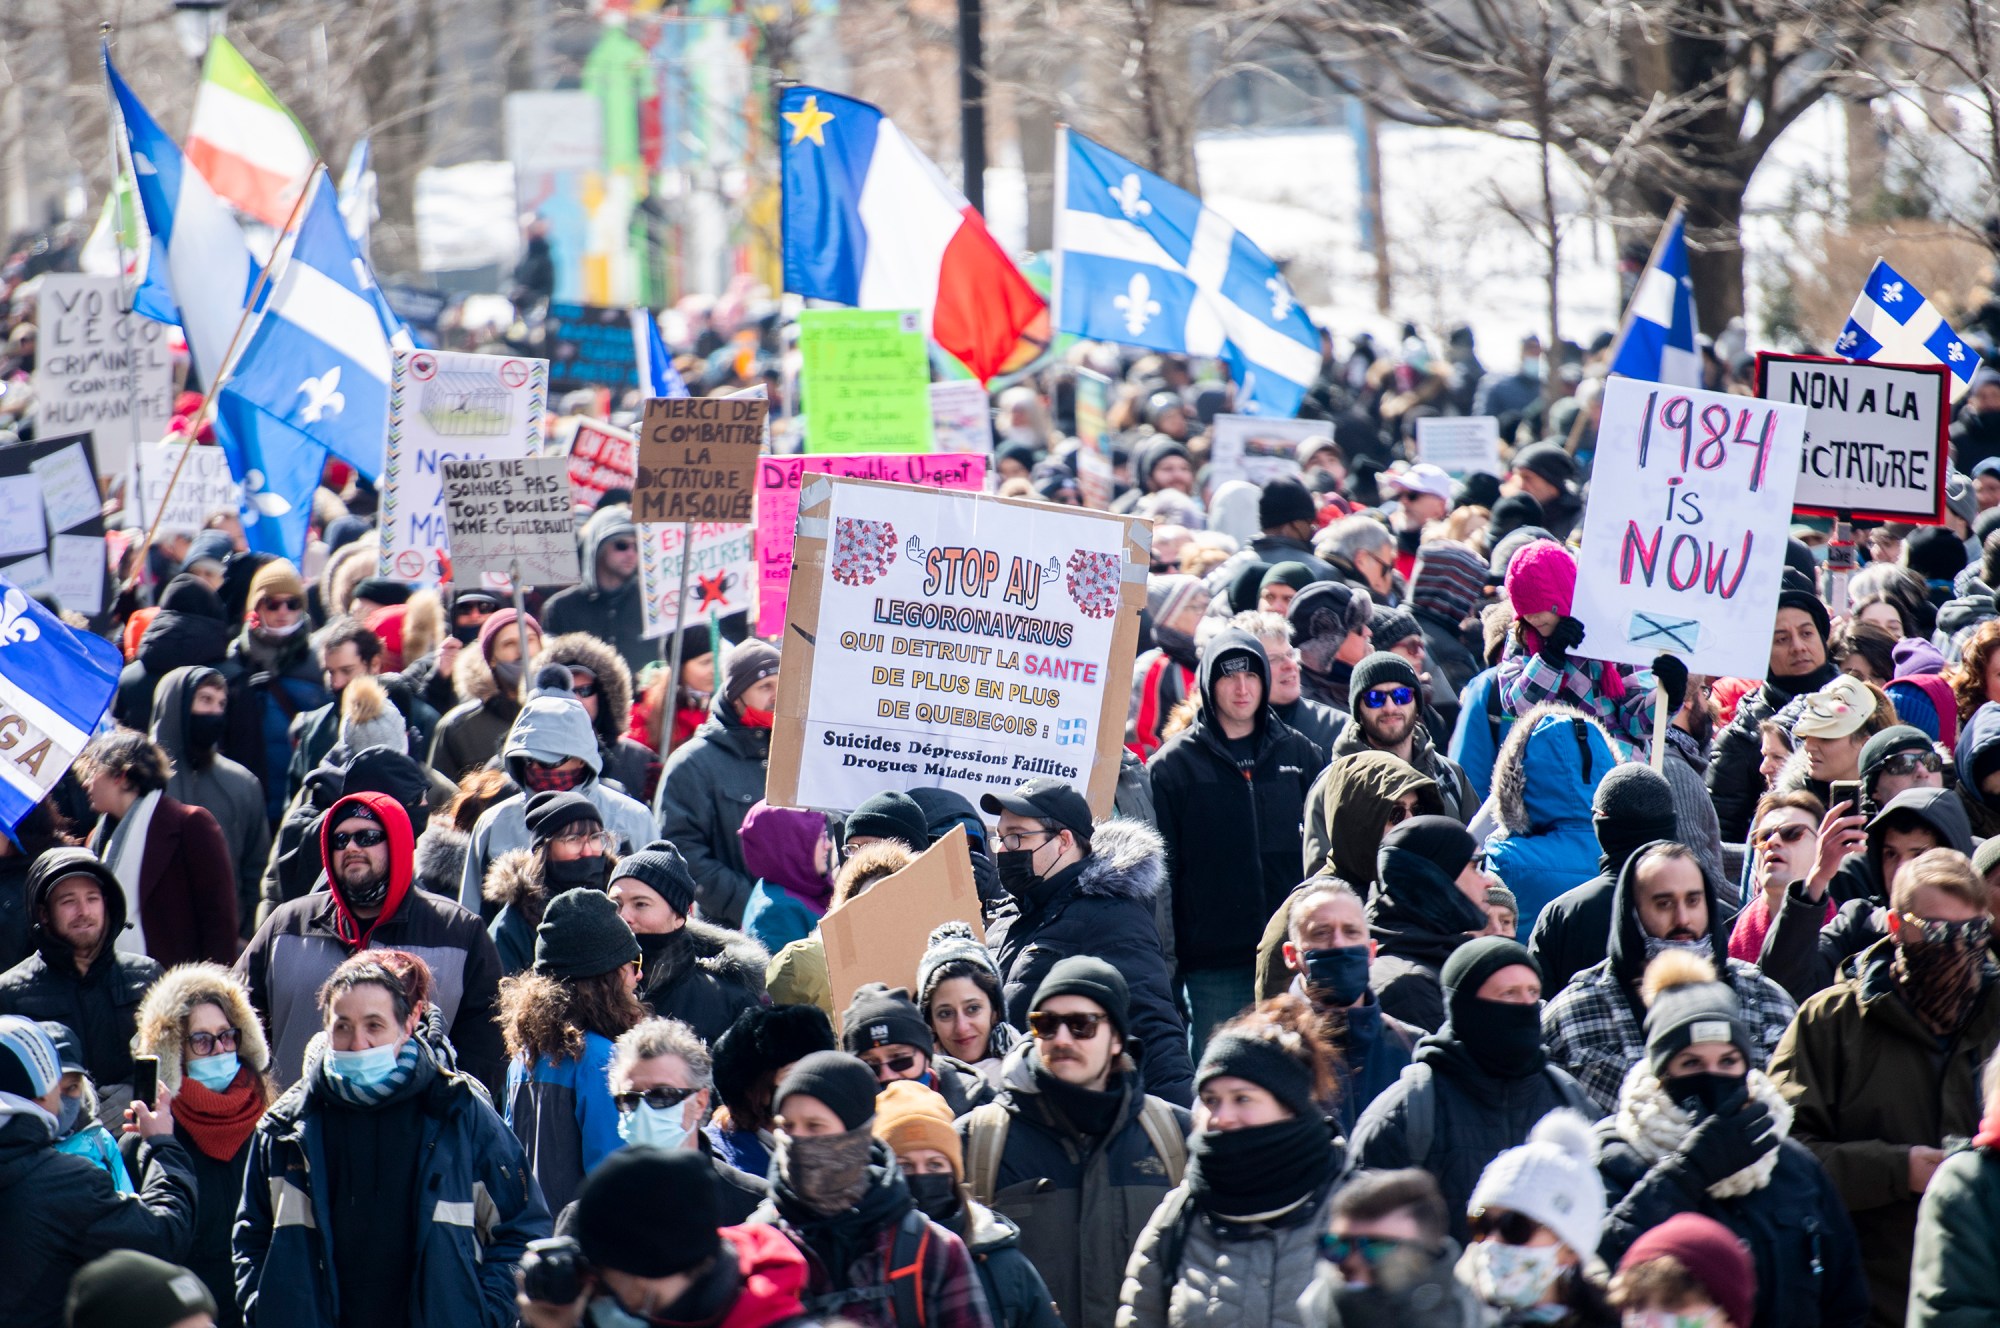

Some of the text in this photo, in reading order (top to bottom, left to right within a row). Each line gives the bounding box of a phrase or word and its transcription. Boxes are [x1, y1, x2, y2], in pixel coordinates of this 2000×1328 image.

[732, 400, 760, 421] DE
[1790, 371, 1920, 421] NON A LA
[653, 422, 763, 444] COMBATTRE
[1638, 390, 1778, 493] 1984
[444, 461, 494, 480] NOUS
[499, 460, 525, 478] NE
[684, 447, 712, 465] LA
[523, 475, 560, 495] PAS
[642, 488, 753, 519] MASQUÉE
[923, 546, 1042, 610] STOP AU
[1619, 519, 1754, 600] NOW
[873, 597, 1073, 648] LEGORONAVIRUS
[840, 631, 1099, 684] QUI DETRUIT LA SANTE
[872, 666, 1060, 708] DE PLUS EN PLUS
[877, 699, 910, 719] DE
[915, 703, 1038, 737] QUEBECOIS
[823, 730, 1078, 779] Suicides Dépressions Faillites
[842, 753, 917, 773] Drogues
[924, 763, 983, 782] Malades
[985, 774, 1012, 785] non
